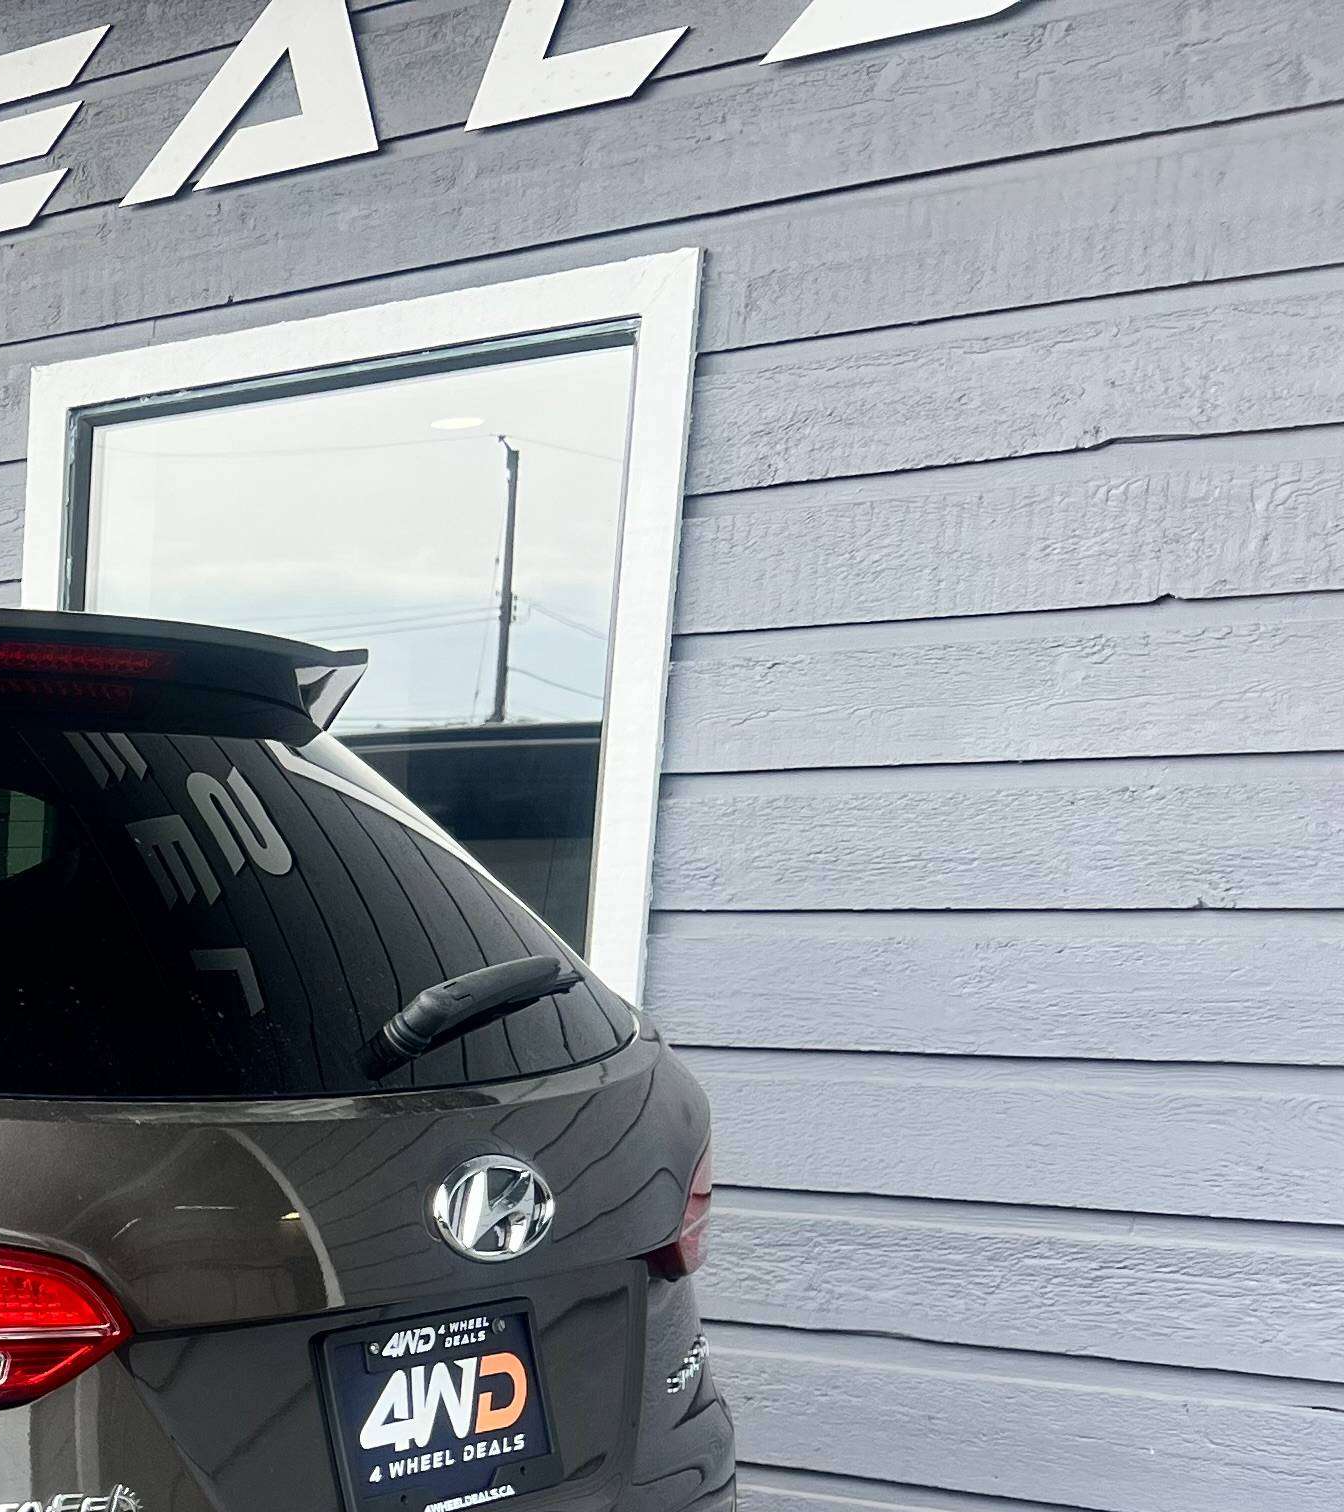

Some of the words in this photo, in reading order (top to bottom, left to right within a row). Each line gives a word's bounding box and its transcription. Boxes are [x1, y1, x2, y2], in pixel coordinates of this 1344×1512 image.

[381, 1326, 436, 1358] 4WD
[449, 1316, 489, 1333] WHEEL
[444, 1330, 486, 1348] DEALS
[359, 1351, 528, 1452] 4WD
[369, 1465, 383, 1483] 4
[388, 1449, 455, 1479] WHEEL
[463, 1433, 525, 1462] DEALS
